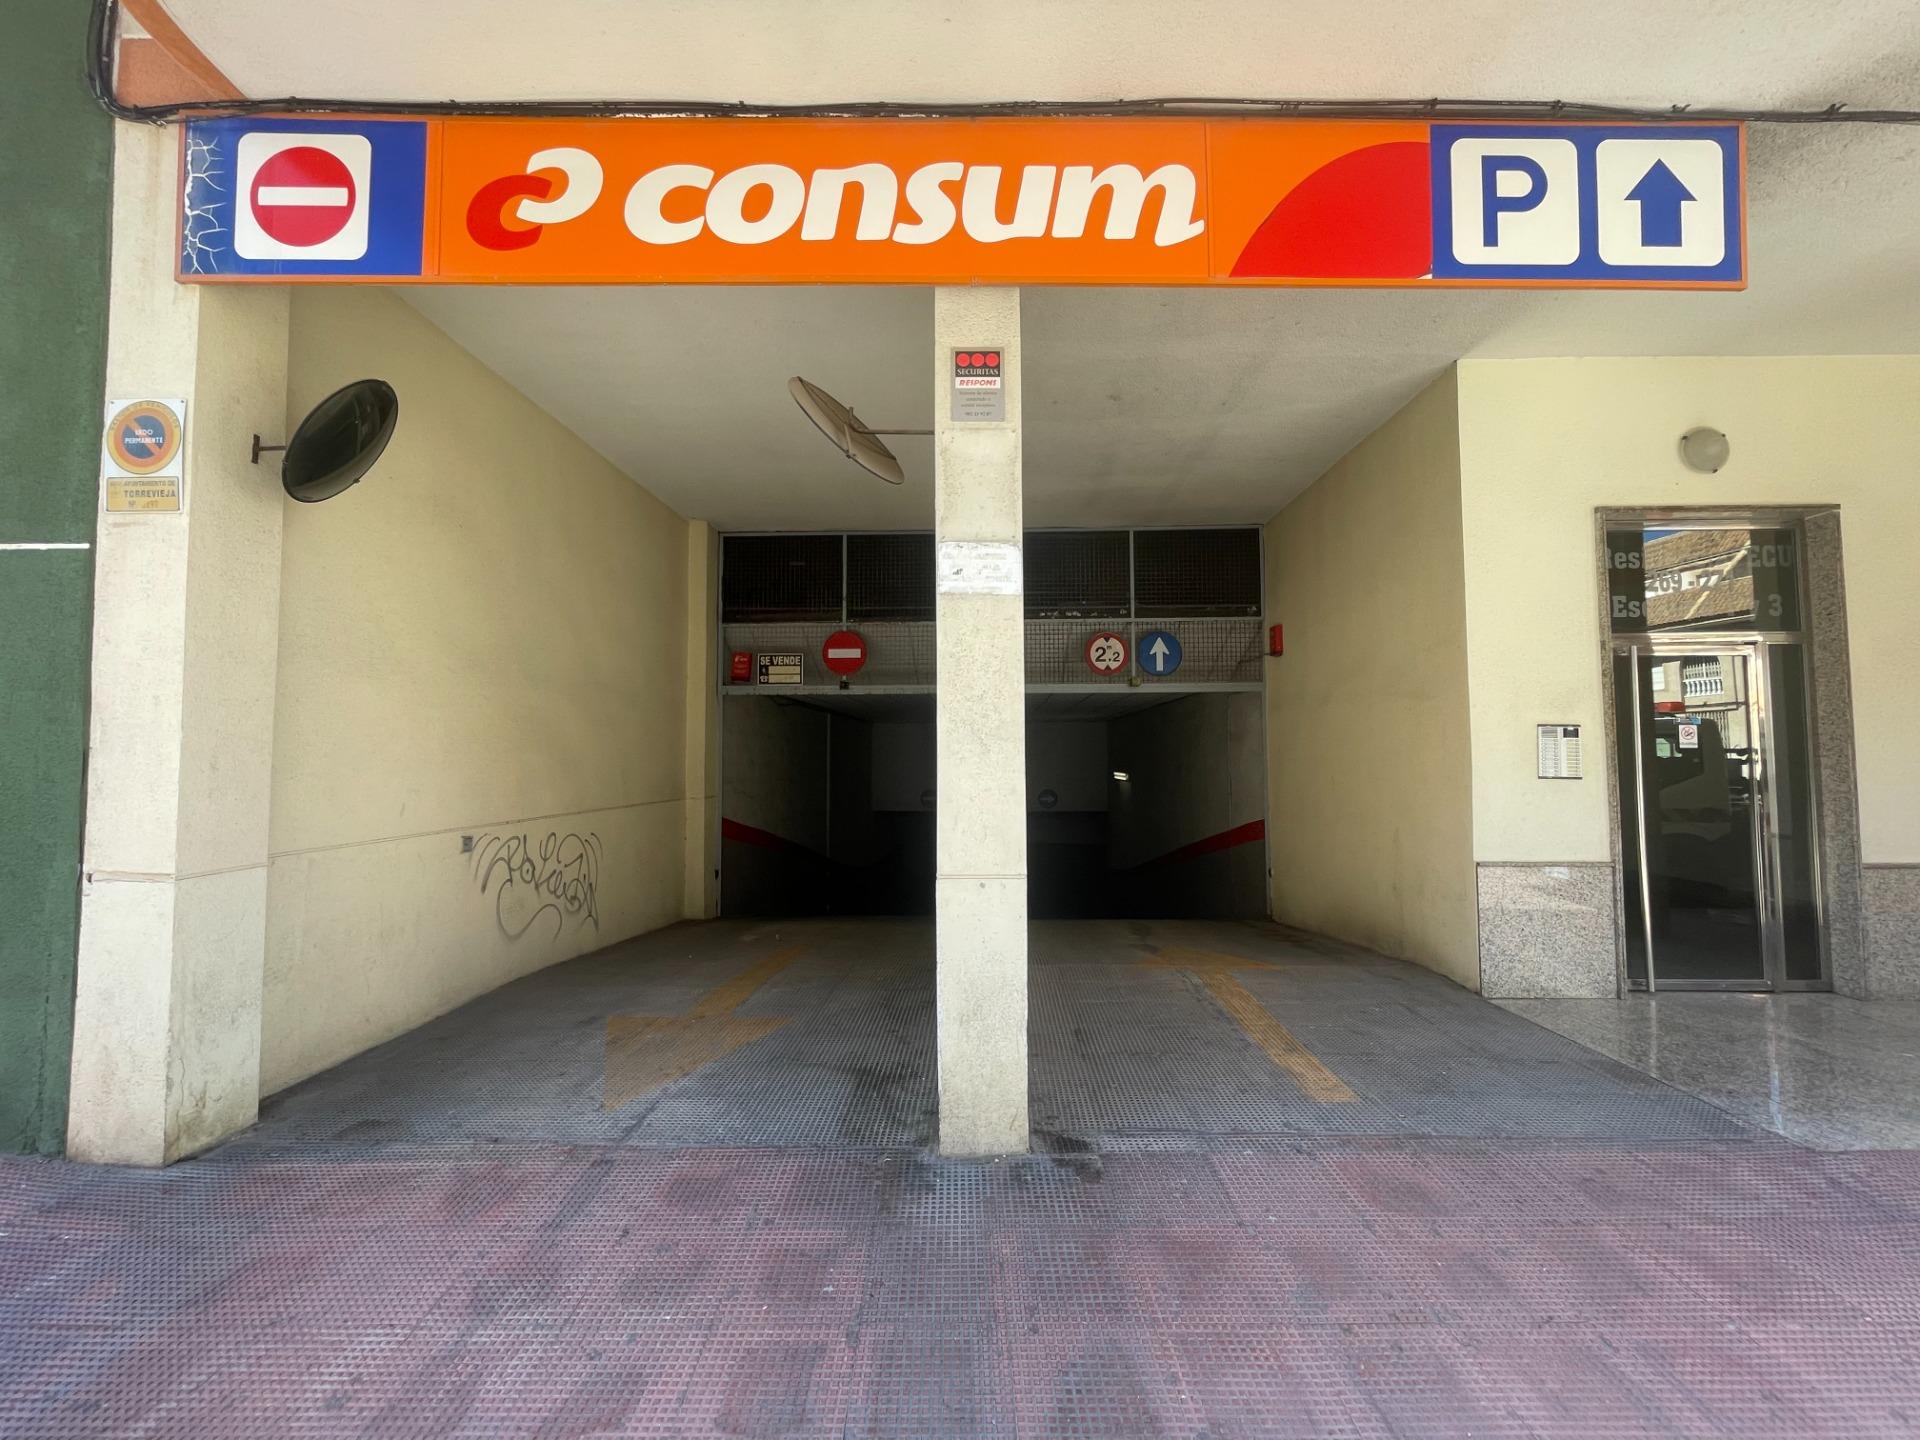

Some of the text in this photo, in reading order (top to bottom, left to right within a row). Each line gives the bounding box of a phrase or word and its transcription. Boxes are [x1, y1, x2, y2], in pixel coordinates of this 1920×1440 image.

[623, 161, 1206, 247] consum
[1481, 154, 1549, 248] P
[760, 656, 801, 665] SE VENDE
